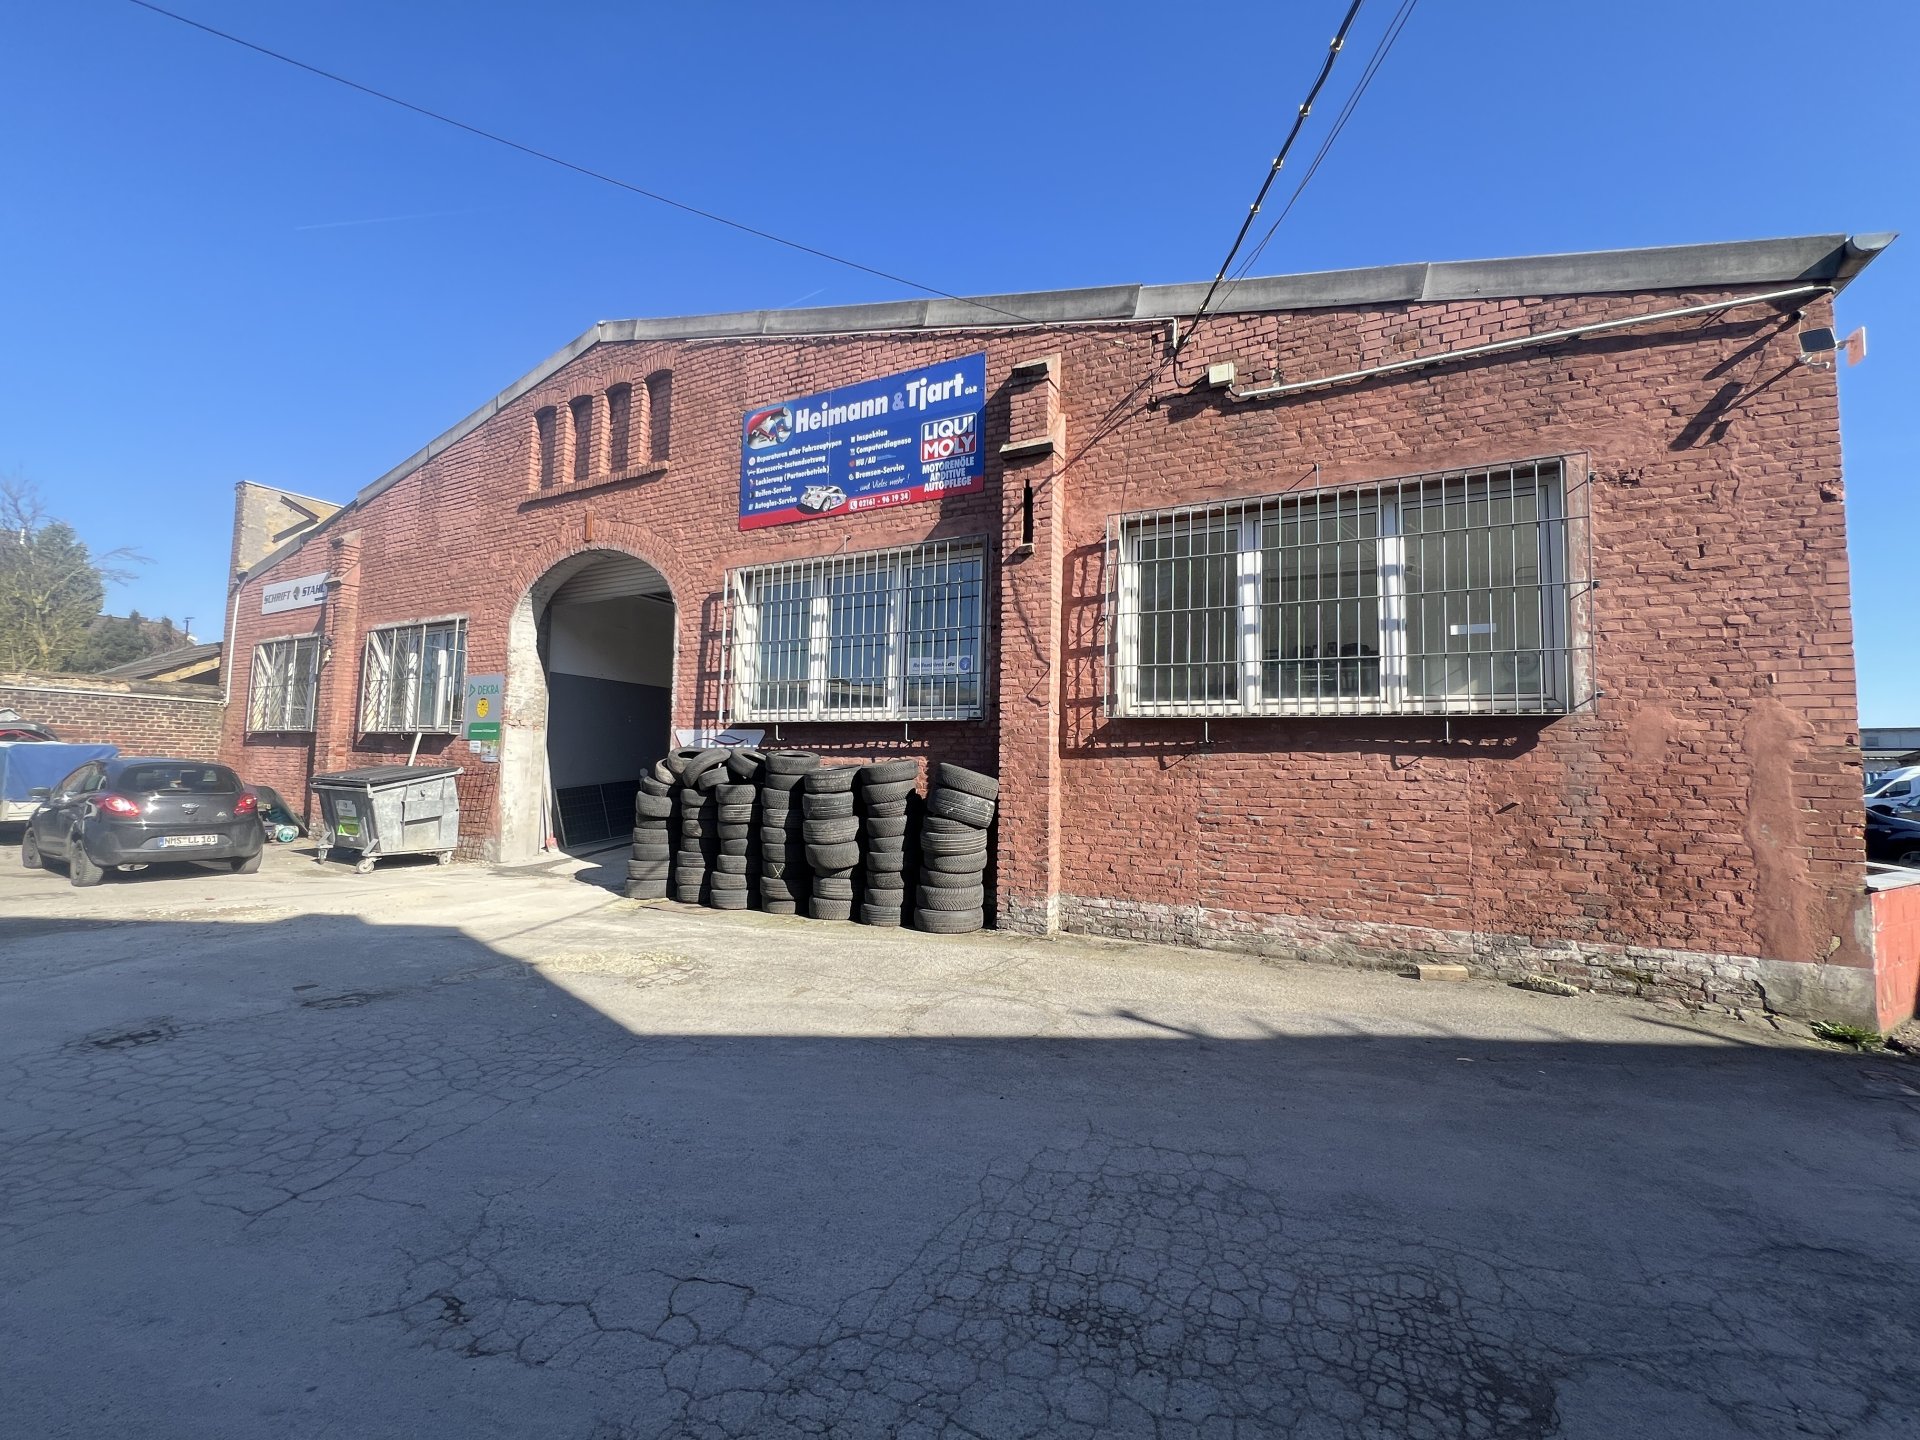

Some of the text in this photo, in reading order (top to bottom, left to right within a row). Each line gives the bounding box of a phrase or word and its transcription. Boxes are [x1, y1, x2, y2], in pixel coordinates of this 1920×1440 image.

[796, 396, 888, 434] Heimann
[892, 392, 905, 410] &
[906, 373, 964, 411] Tjart
[856, 430, 888, 442] Inspektion
[924, 416, 973, 441] LIQUI
[756, 440, 842, 463] Reparaturen aller Fahrzeugtypen
[856, 438, 911, 454] Computerdiagnose
[924, 434, 974, 460] MOLY
[855, 464, 905, 479] Bremsen-Service
[922, 456, 974, 474] MOTORENÖLE
[756, 475, 783, 486] Lackierung
[930, 468, 966, 482] ADDITIVE
[755, 485, 792, 498] Reifen-Service
[924, 476, 971, 492] AUTOPFLEGE
[755, 496, 797, 509] Autoglas-Service
[859, 498, 875, 507] 02161
[900, 492, 908, 500] 34
[264, 591, 291, 604] SCHRIFT
[478, 684, 499, 695] DEKRA
